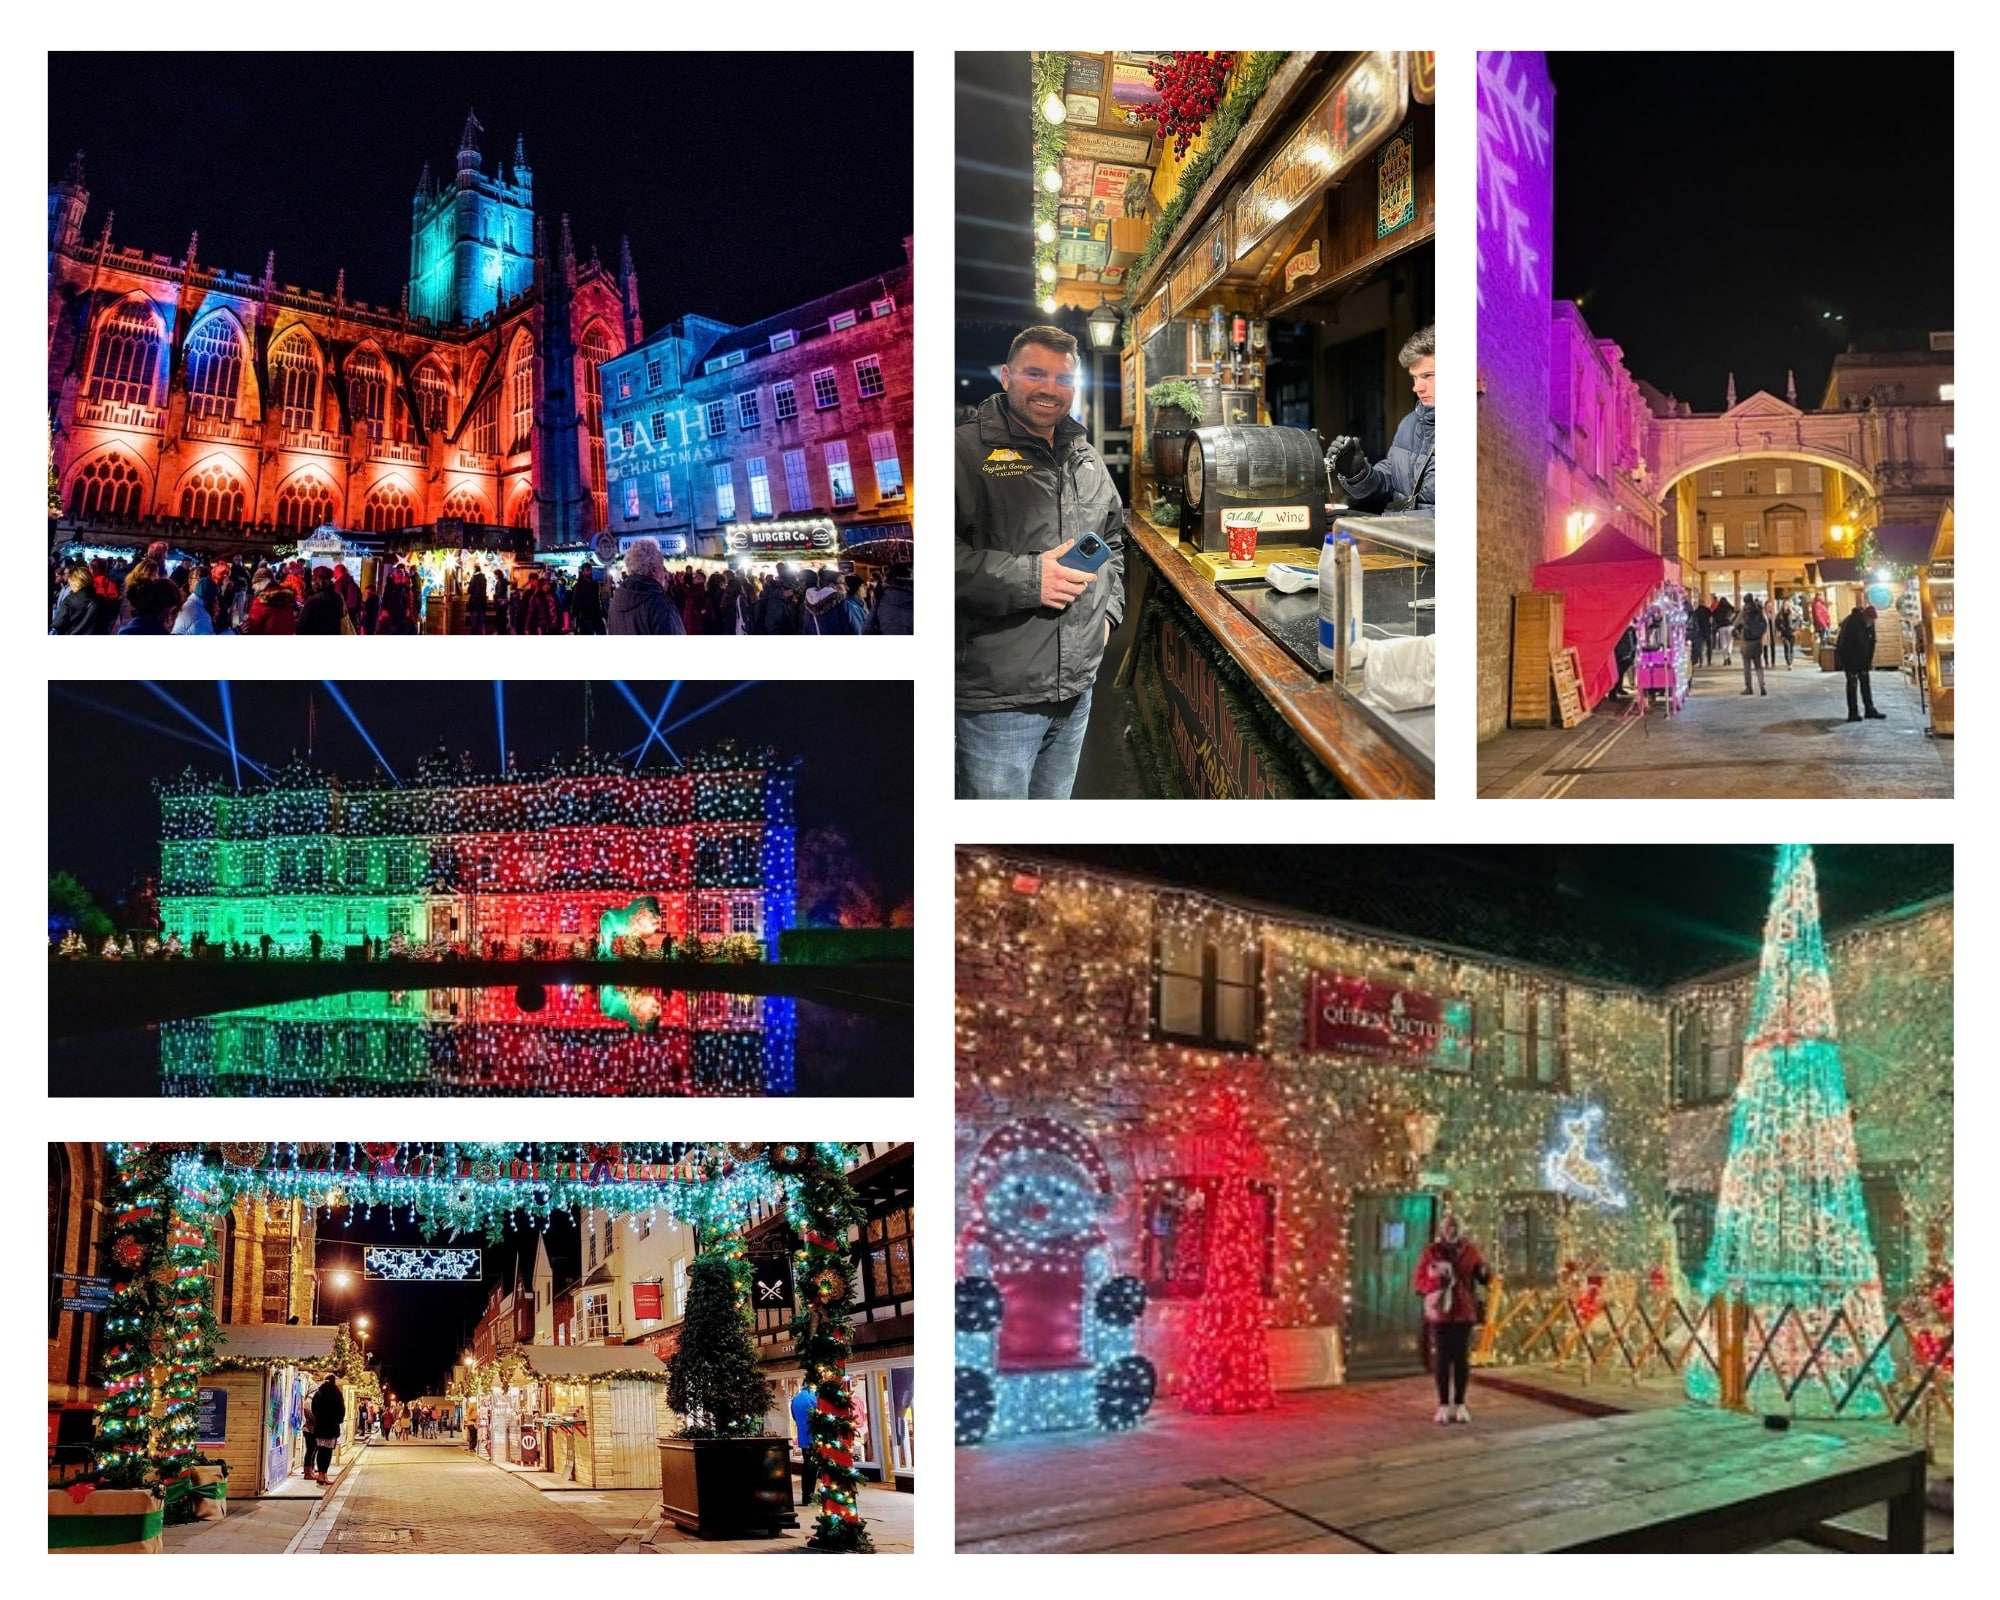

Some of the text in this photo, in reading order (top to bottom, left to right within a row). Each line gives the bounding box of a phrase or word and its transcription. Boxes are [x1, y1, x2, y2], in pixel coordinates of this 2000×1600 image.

[604, 405, 709, 464] BATH
[619, 443, 713, 478] CHRISTMAS
[982, 463, 1034, 474] English Cottage
[1275, 511, 1305, 523] Wine
[751, 531, 809, 543] BURGER Co.
[1323, 1006, 1385, 1029] QUEEN
